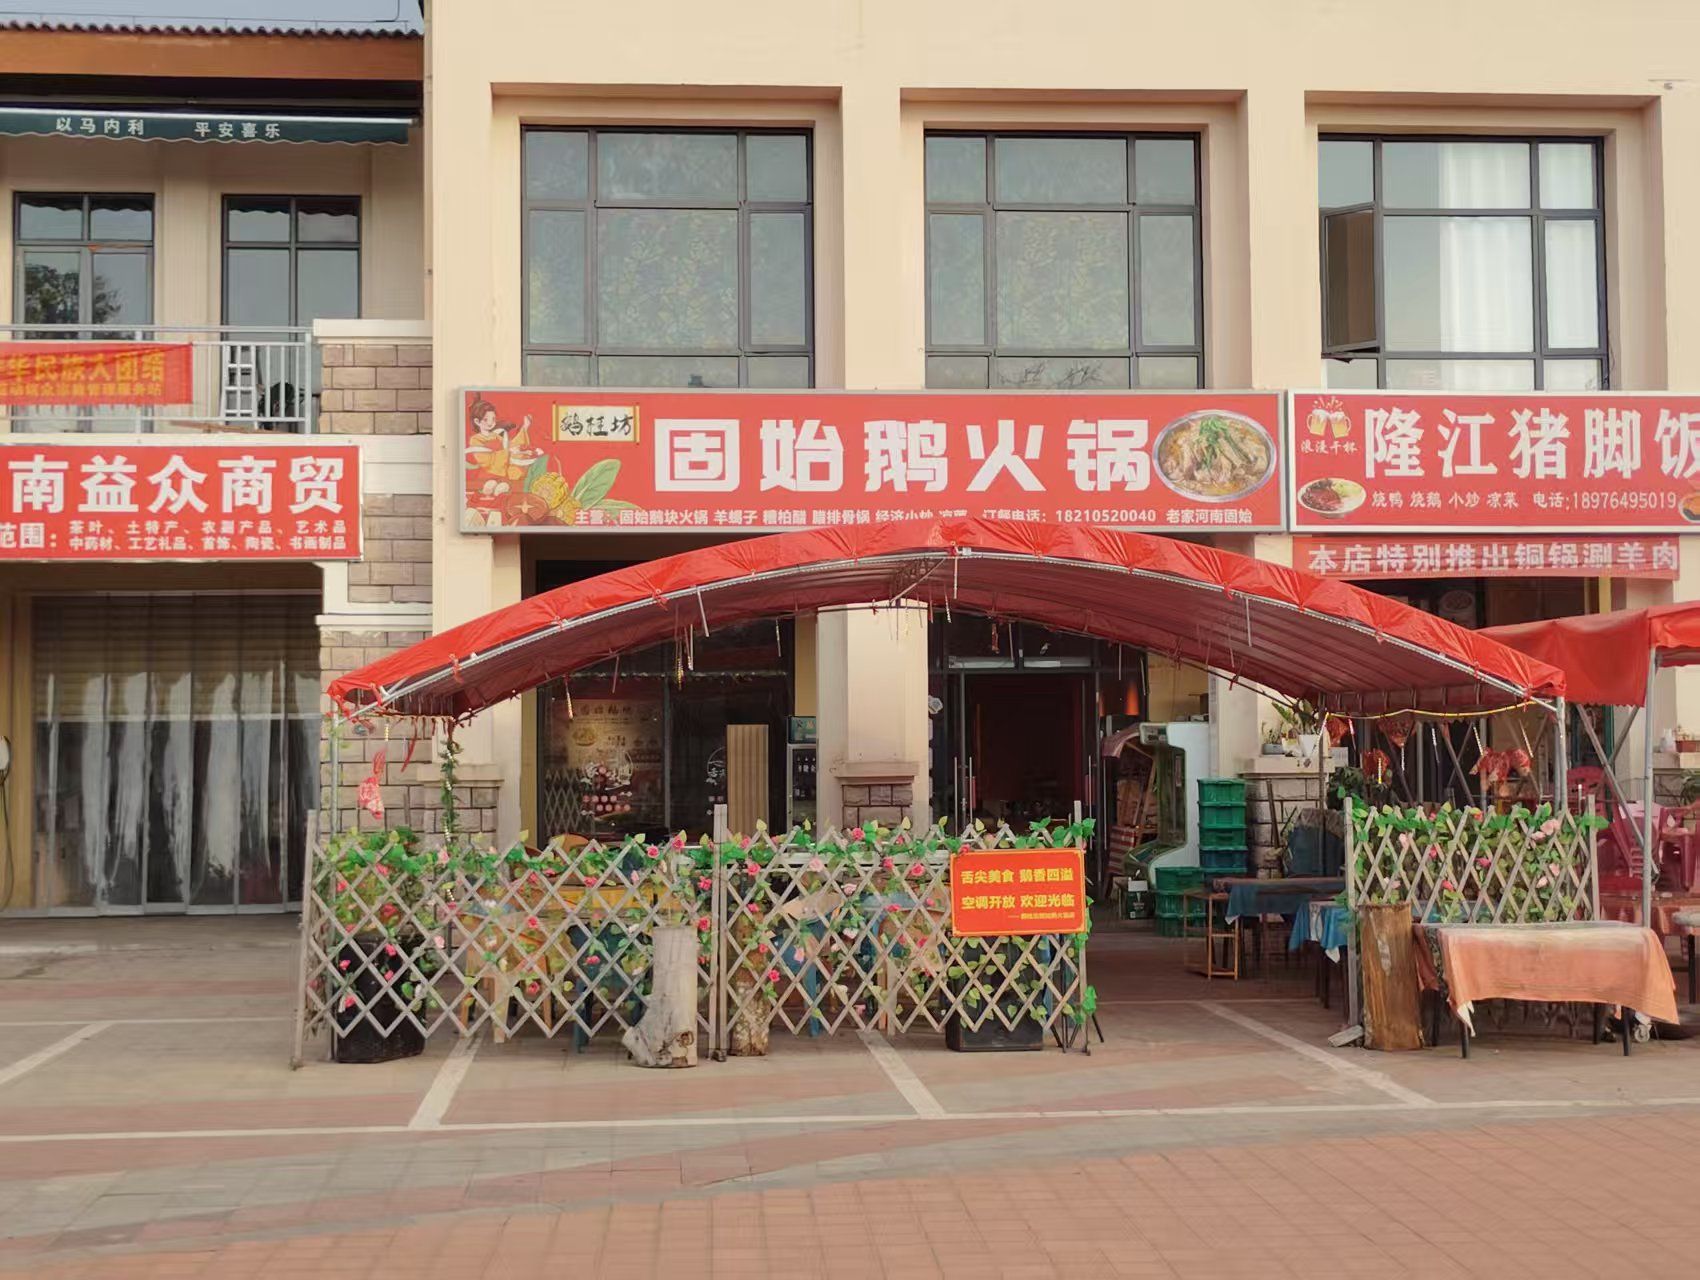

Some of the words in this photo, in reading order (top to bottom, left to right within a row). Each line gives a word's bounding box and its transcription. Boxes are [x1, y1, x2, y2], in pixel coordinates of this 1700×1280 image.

[55, 117, 145, 136] 以马内利
[194, 122, 281, 139] 平安喜乐
[0, 348, 166, 383] 华民族大团结
[1301, 440, 1358, 455] 浪漫干杯
[1364, 407, 1700, 479] 隆江猪脚饭
[654, 418, 1151, 493] 固始鹅火锅
[8, 454, 345, 514] 南益众商贸
[1371, 491, 1403, 508] 烧鸭
[1410, 491, 1442, 508] 烧鹅
[1449, 491, 1480, 508] 小炒
[1487, 491, 1519, 508] 凉菜
[714, 509, 758, 525] 羊蝎子
[1166, 508, 1253, 524] 老家河南固始
[1308, 542, 1678, 575] 本店特别推出铜锅涮羊肉
[960, 869, 1014, 884] 舌尖美食
[1019, 867, 1073, 882] 鹅香四溢
[961, 895, 1015, 909] 空调开放
[1020, 893, 1075, 908] 欢迎光临
